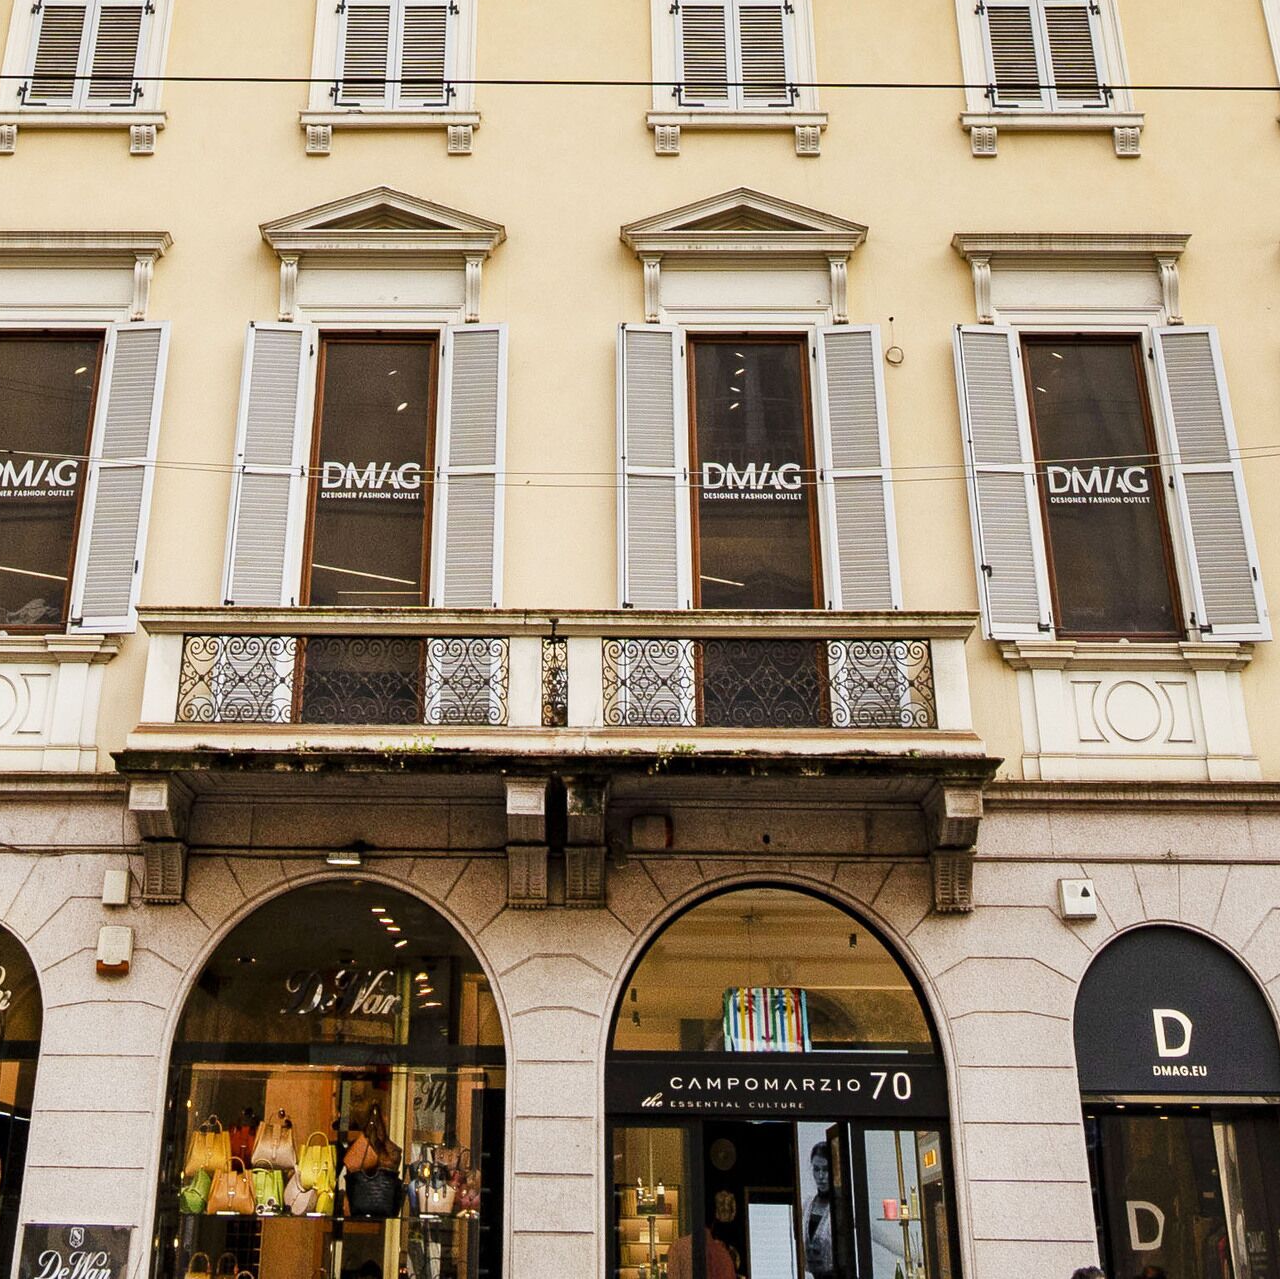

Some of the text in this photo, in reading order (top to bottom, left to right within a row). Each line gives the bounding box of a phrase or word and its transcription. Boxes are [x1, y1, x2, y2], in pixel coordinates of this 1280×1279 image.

[322, 461, 421, 490] DMAG
[702, 462, 802, 490] DMAG
[1046, 465, 1150, 494] DMAG
[13, 490, 46, 498] FASHION
[48, 490, 75, 498] OUTLET
[320, 492, 420, 500] DESIGNER FASHION OUTLET
[704, 492, 802, 500] DESIGNER FASHION OUTLET
[1050, 496, 1151, 504] DESIGNER FASHION OUTLET
[1152, 1008, 1193, 1058] D
[1152, 1065, 1208, 1076] DMAG.EU
[670, 1072, 912, 1100] CAMPOMARZIO 70
[641, 1092, 805, 1109] the ESSENTIAL CULTURE
[1126, 1200, 1166, 1251] D
